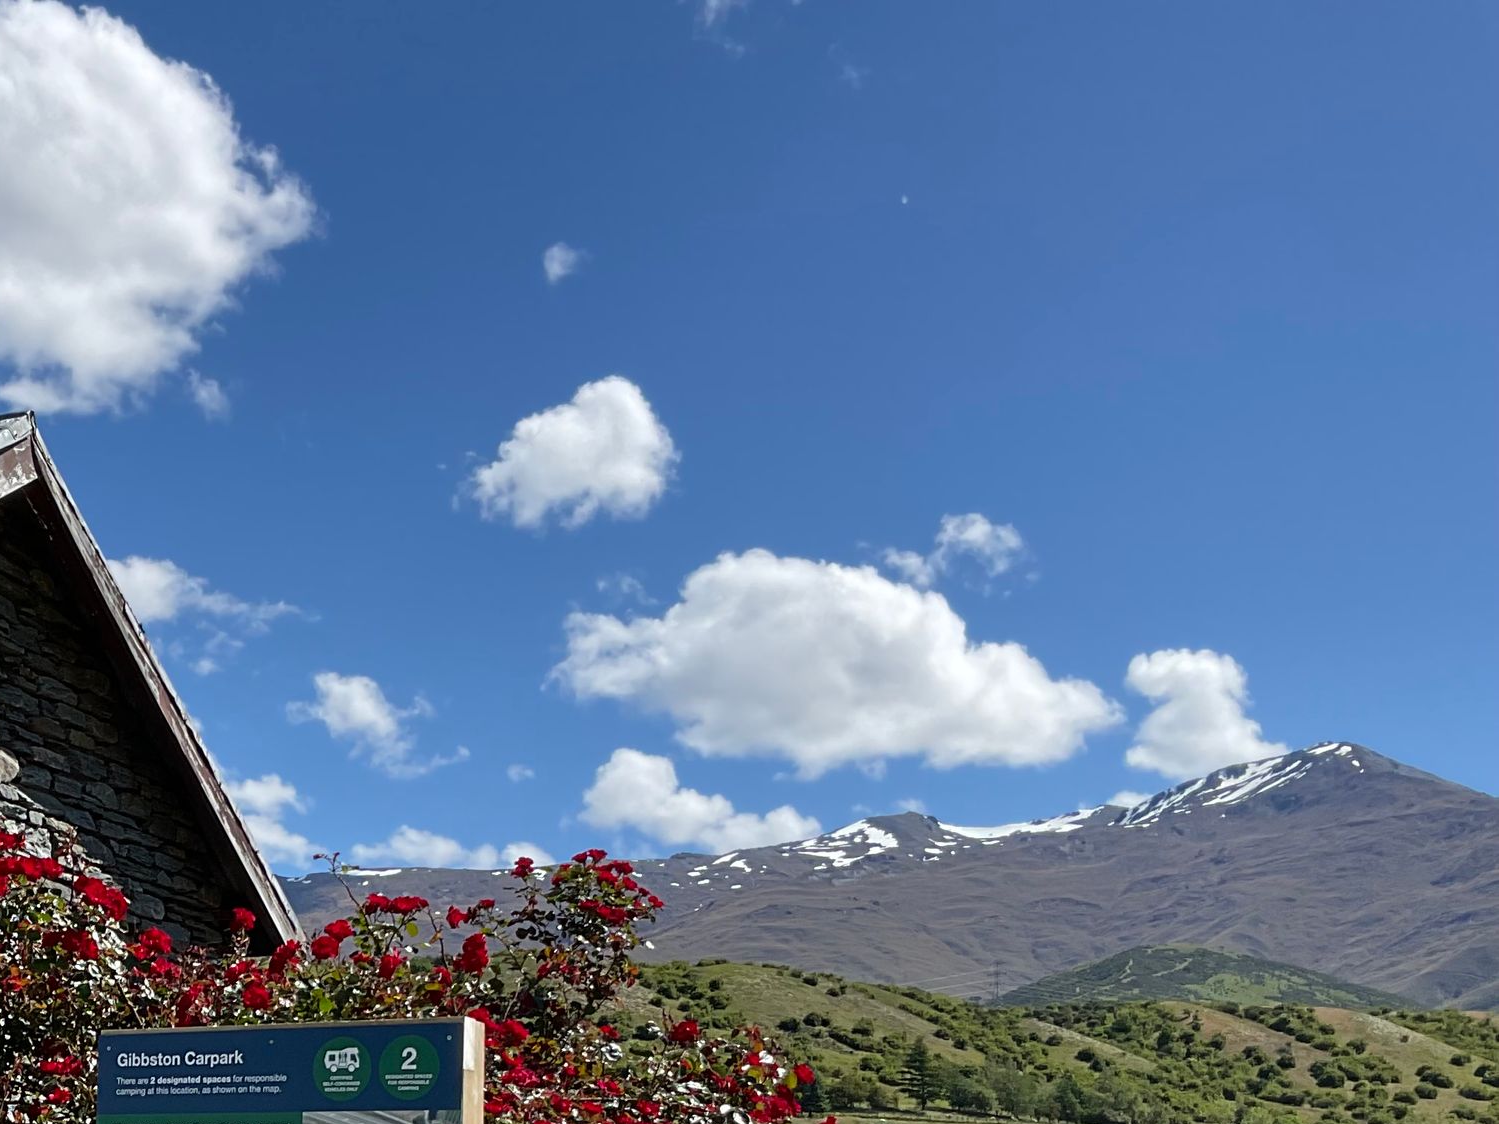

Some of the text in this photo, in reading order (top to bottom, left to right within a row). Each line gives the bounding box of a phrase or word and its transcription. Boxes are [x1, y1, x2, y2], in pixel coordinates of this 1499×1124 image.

[117, 1050, 243, 1067] Gibbston Carpark
[401, 1047, 418, 1070] 2
[157, 1076, 200, 1086] designated
[202, 1076, 231, 1085] spaces
[245, 1074, 287, 1083] responsible
[115, 1088, 145, 1096] camping
[170, 1086, 201, 1095] location,
[249, 1085, 261, 1093] the
[262, 1086, 282, 1094] map.
